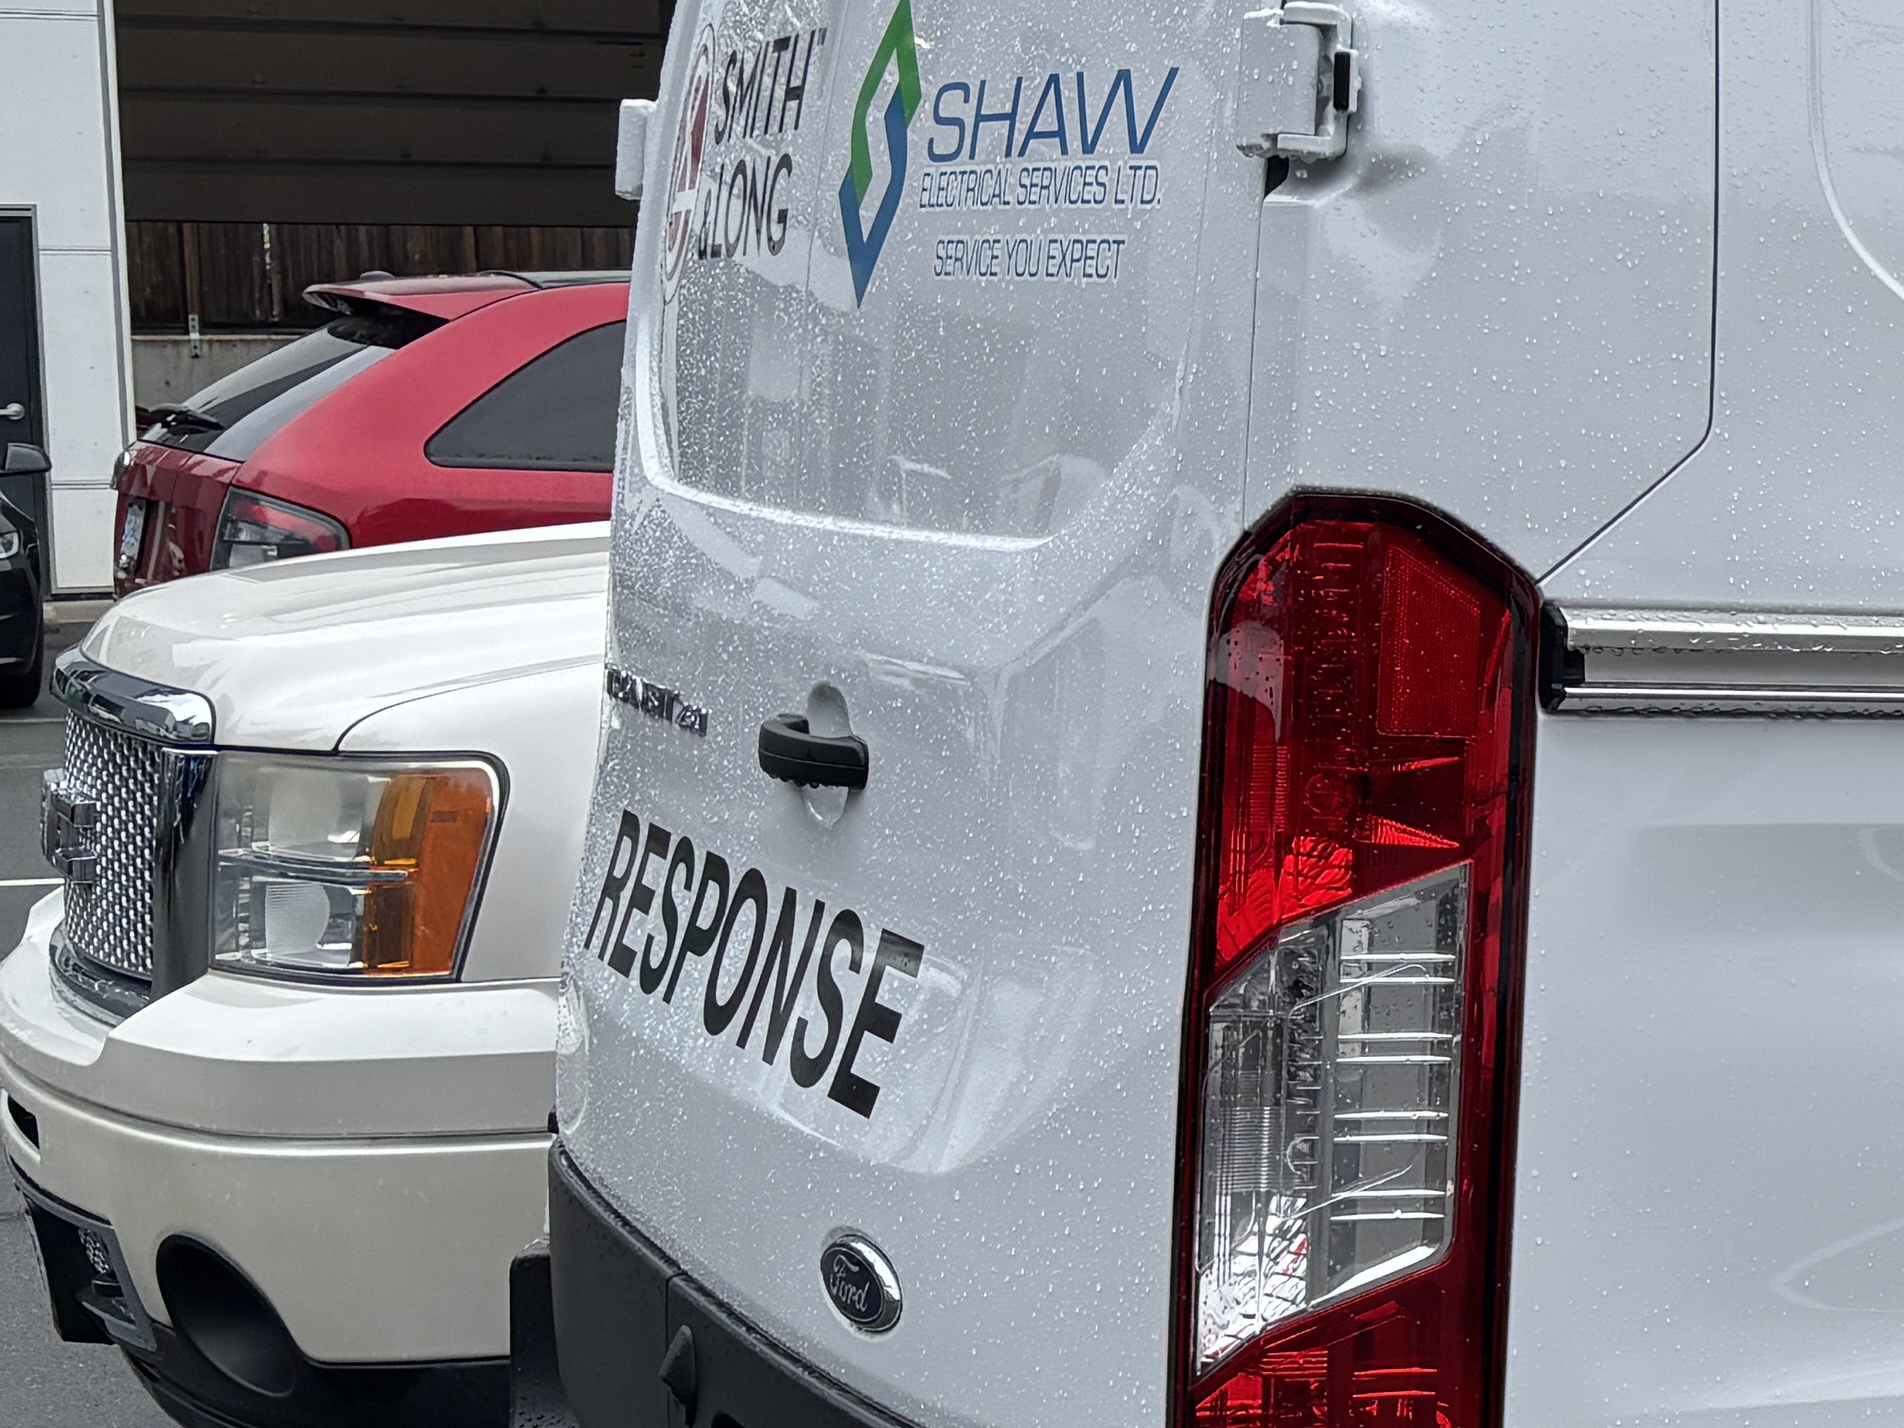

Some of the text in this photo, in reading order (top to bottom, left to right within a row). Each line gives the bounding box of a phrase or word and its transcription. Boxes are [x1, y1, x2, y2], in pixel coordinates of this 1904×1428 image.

[715, 29, 819, 145] SMITH
[927, 67, 1180, 163] SHAW
[919, 165, 1162, 210] ELECTRICAL SERVICES LTD.
[933, 238, 1125, 280] SERVICE YOU EXPECT
[584, 809, 925, 1120] RESPONSE
[829, 1254, 871, 1313] Ford
